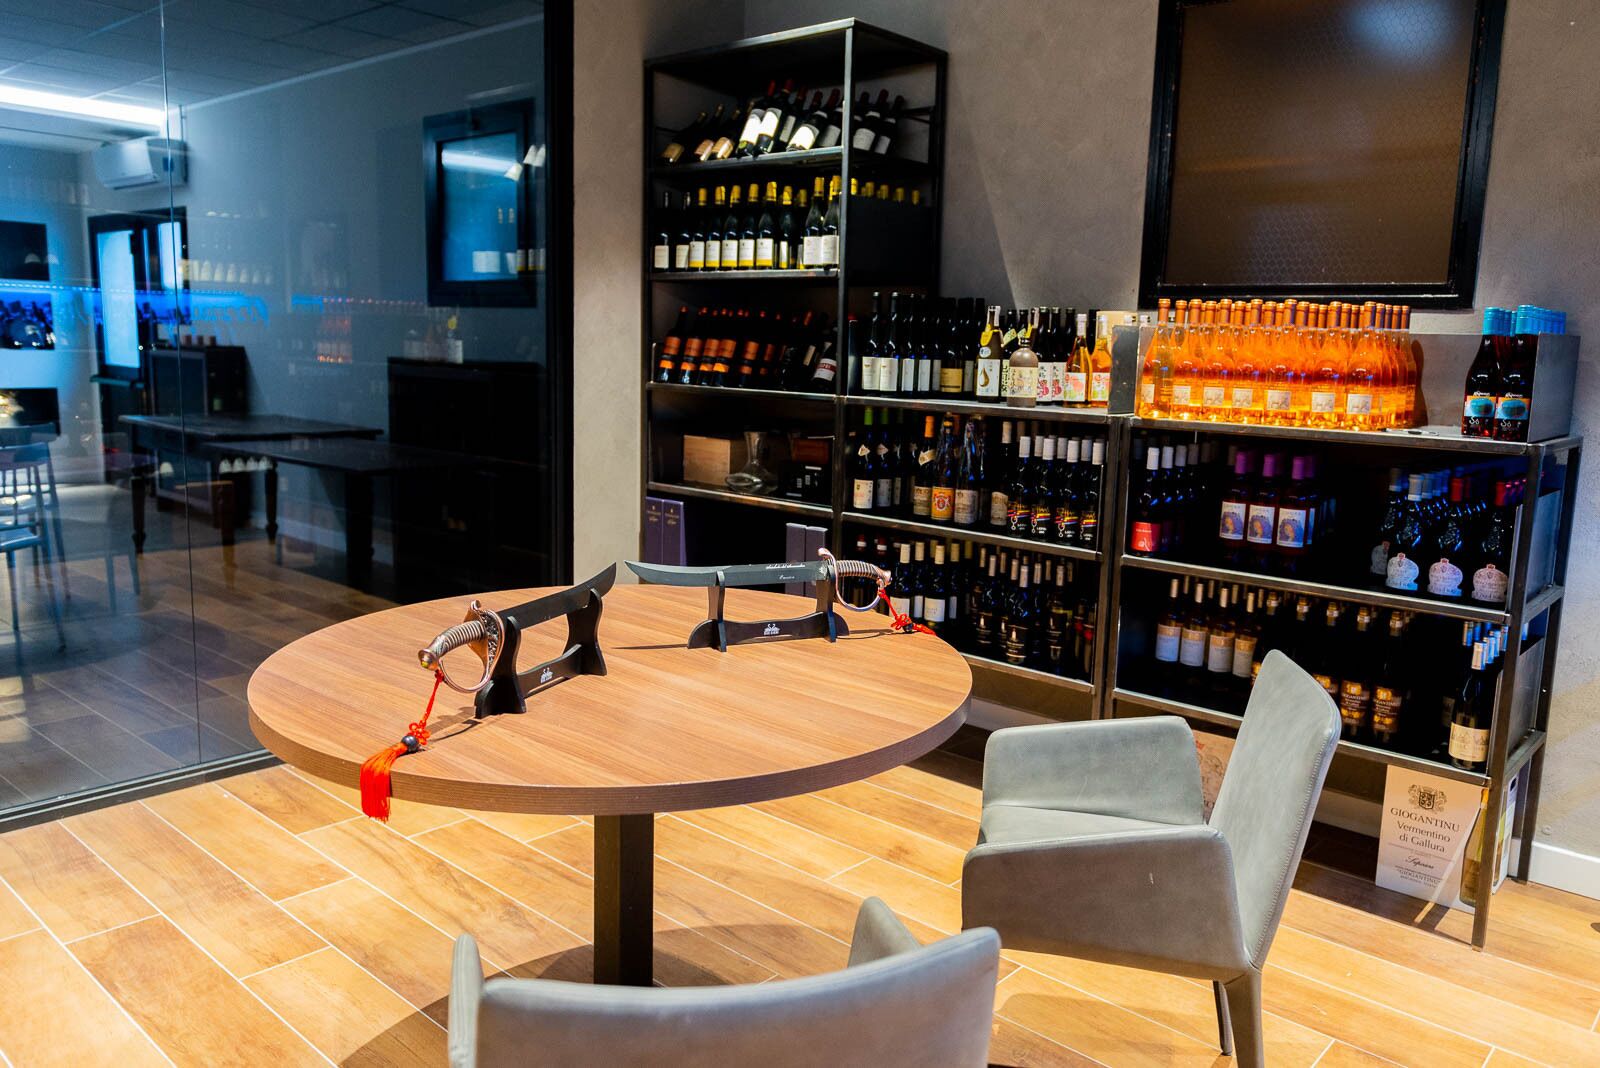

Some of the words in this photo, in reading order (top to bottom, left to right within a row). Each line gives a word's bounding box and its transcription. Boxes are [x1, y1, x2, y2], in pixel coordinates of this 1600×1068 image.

[1390, 807, 1460, 832] GIOGANTINU
[1397, 820, 1451, 842] Vermentino
[1399, 833, 1408, 842] di
[1411, 836, 1445, 853] Gallura
